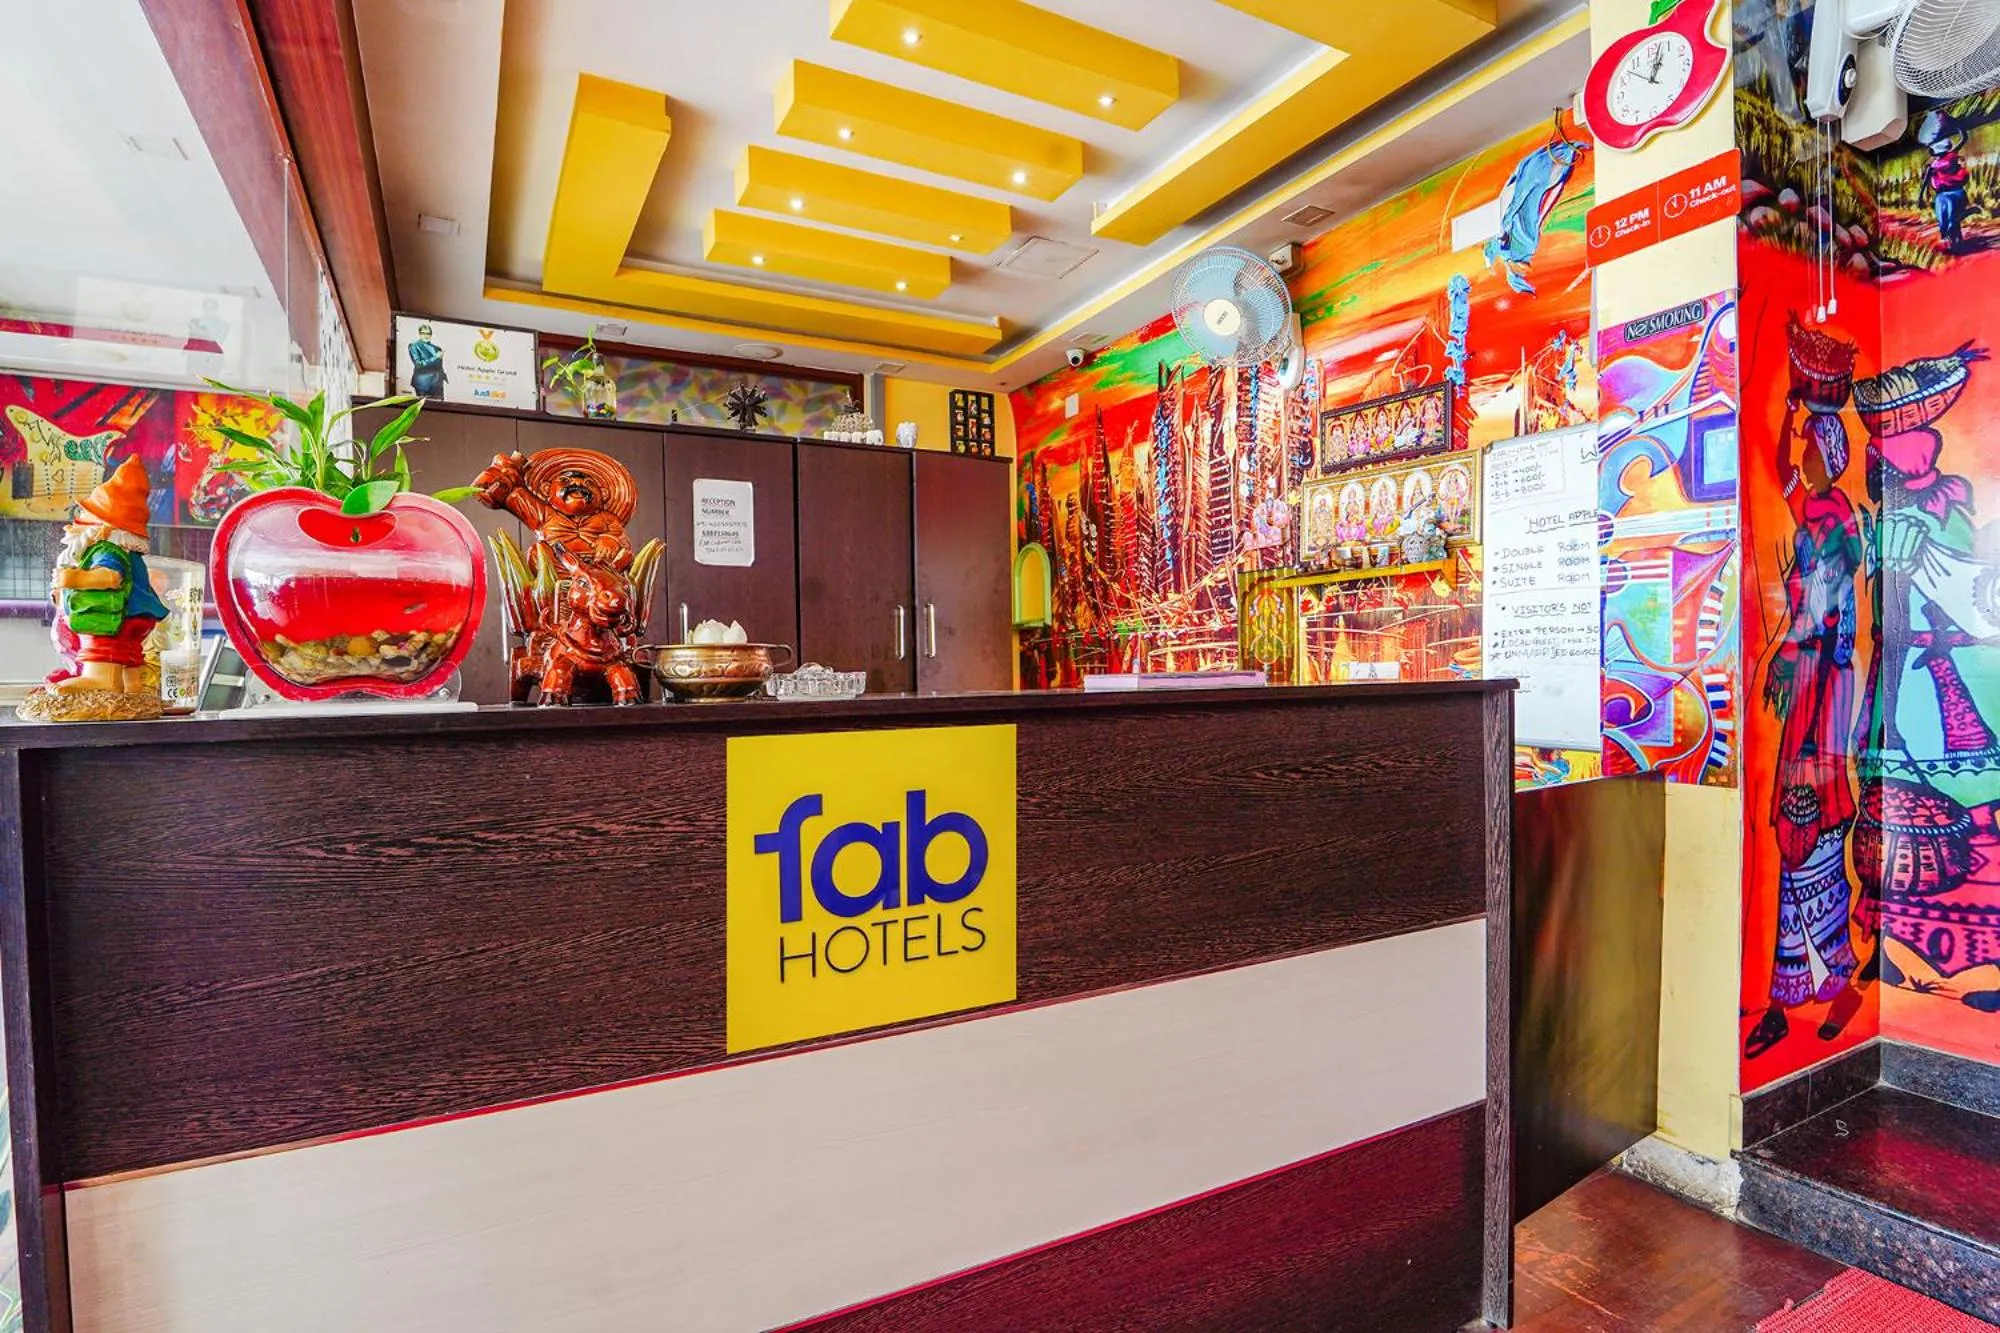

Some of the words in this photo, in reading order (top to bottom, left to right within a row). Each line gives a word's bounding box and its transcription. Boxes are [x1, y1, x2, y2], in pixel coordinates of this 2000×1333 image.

[1689, 187, 1701, 199] 11
[1703, 175, 1728, 194] AM
[1689, 184, 1737, 208] Check-out
[1614, 217, 1628, 231] 12
[1629, 207, 1650, 225] PM
[1614, 219, 1651, 239] Check-in
[1649, 303, 1702, 332] SMOKING
[1528, 515, 1565, 529] HOTEL
[1501, 546, 1545, 560] DOUBLE
[1501, 561, 1543, 574] SINGLE
[1500, 577, 1537, 588] SUITE
[1572, 602, 1592, 611] NOT
[754, 789, 989, 924] fab
[779, 906, 987, 983] HOTELS
